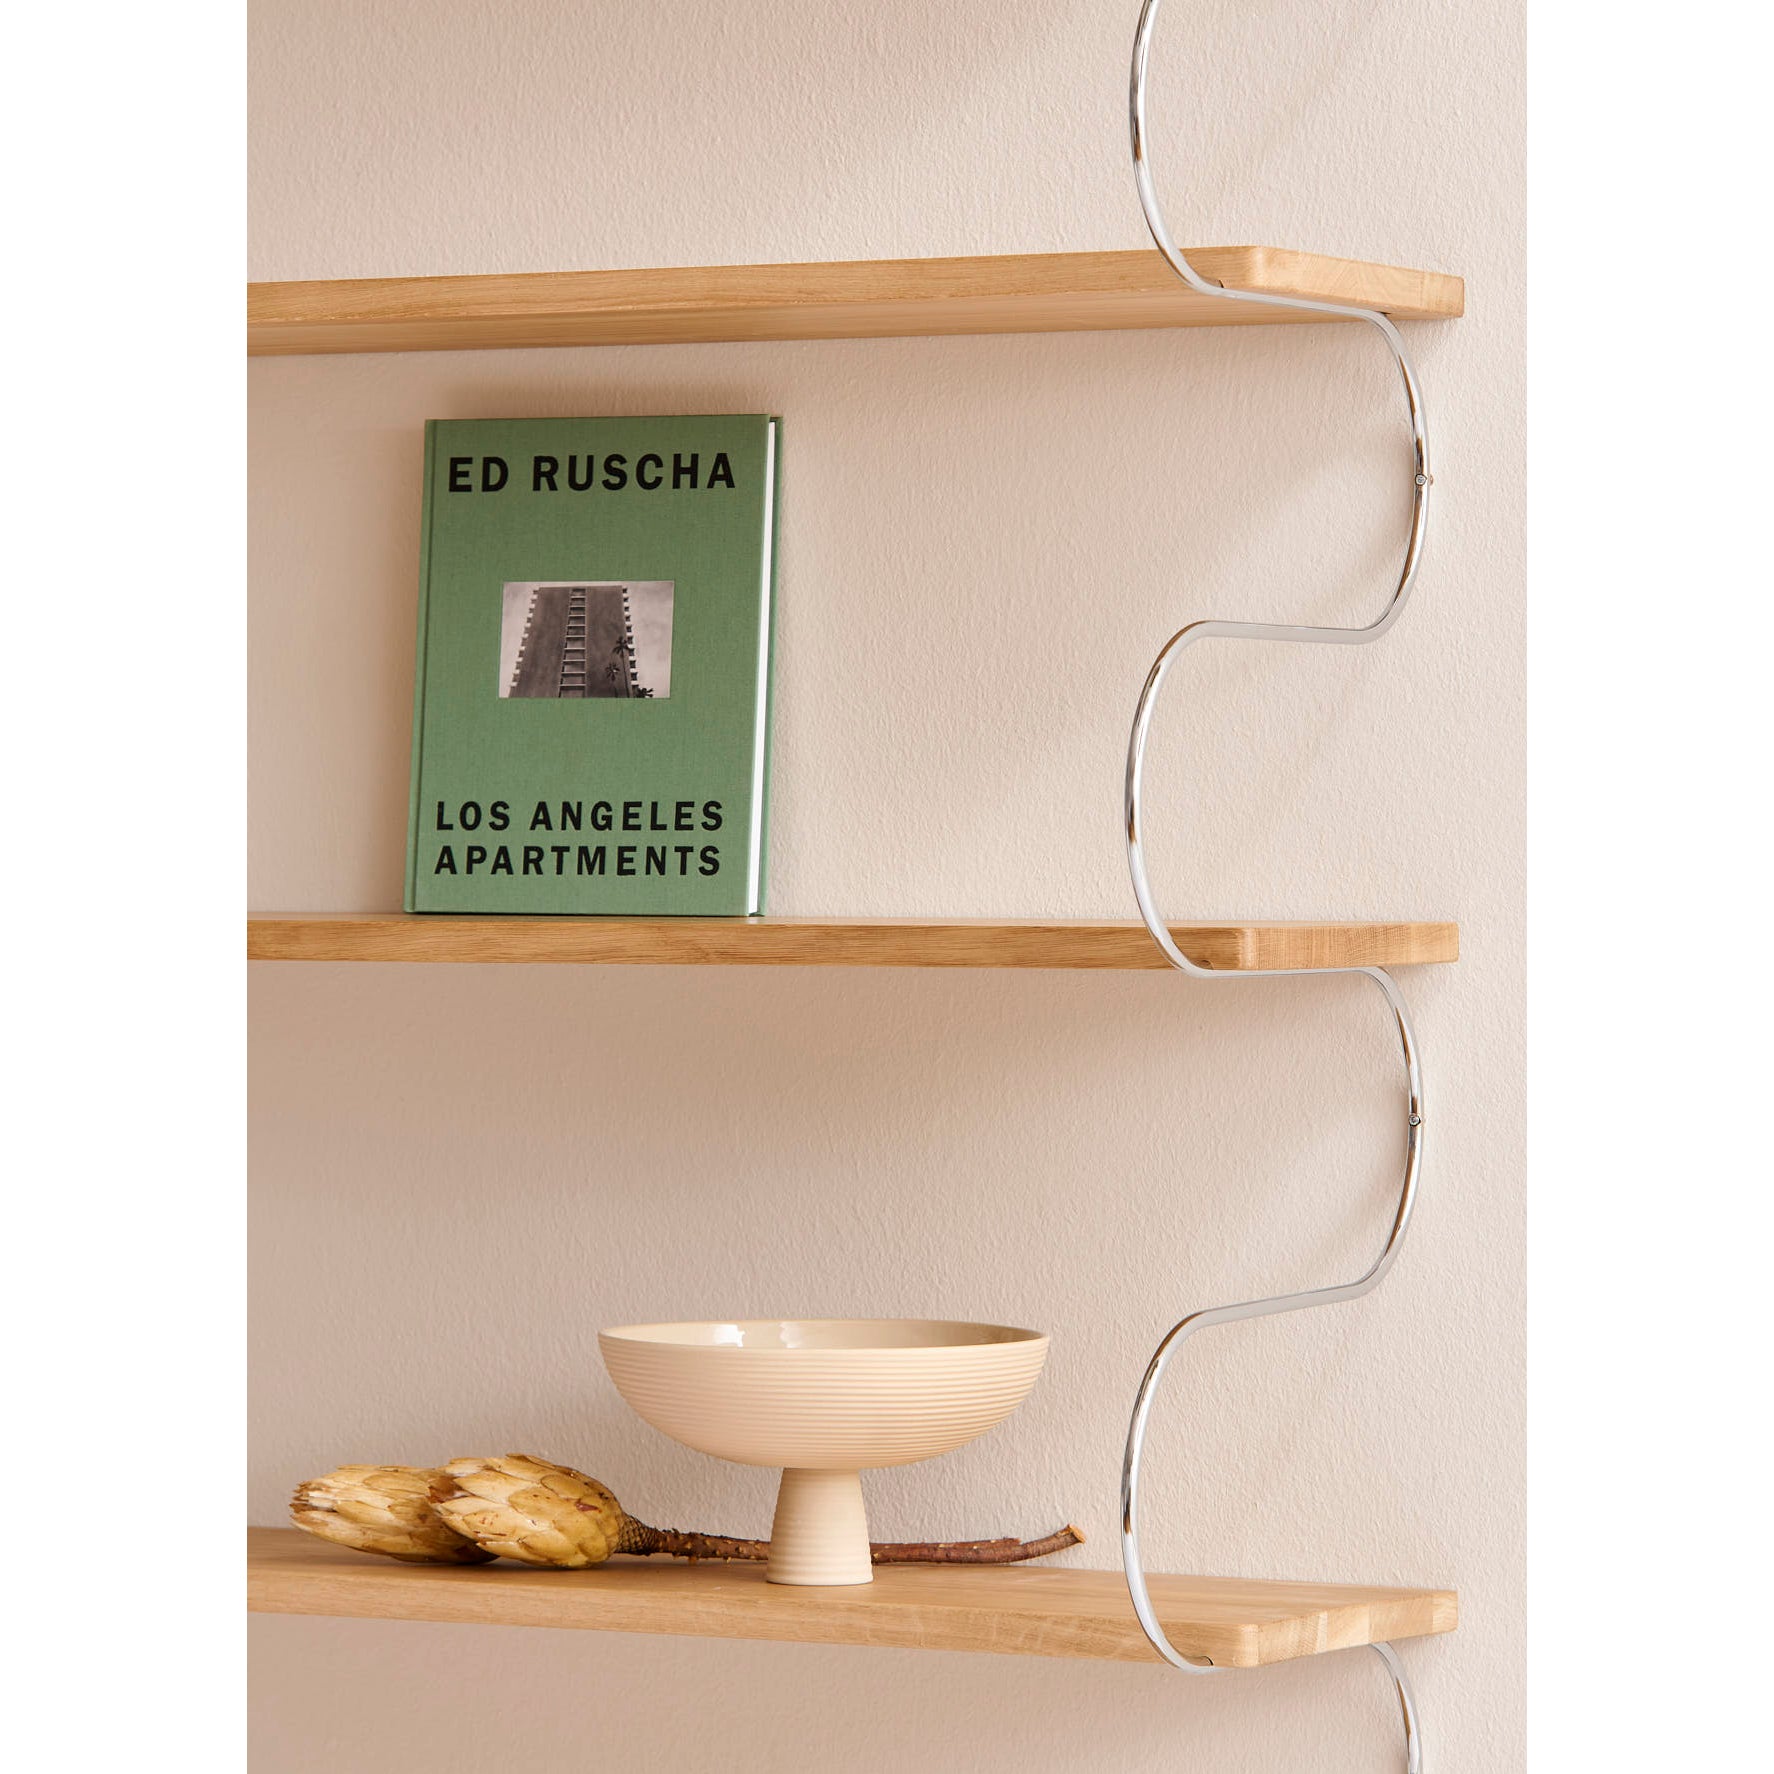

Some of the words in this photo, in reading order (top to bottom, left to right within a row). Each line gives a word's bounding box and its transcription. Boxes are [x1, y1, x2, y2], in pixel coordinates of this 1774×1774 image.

[448, 456, 510, 493] ED
[532, 452, 736, 492] RUSCHA
[436, 800, 511, 831] LOS
[529, 800, 723, 832] ANGELES
[434, 845, 720, 877] APARTMENTS
